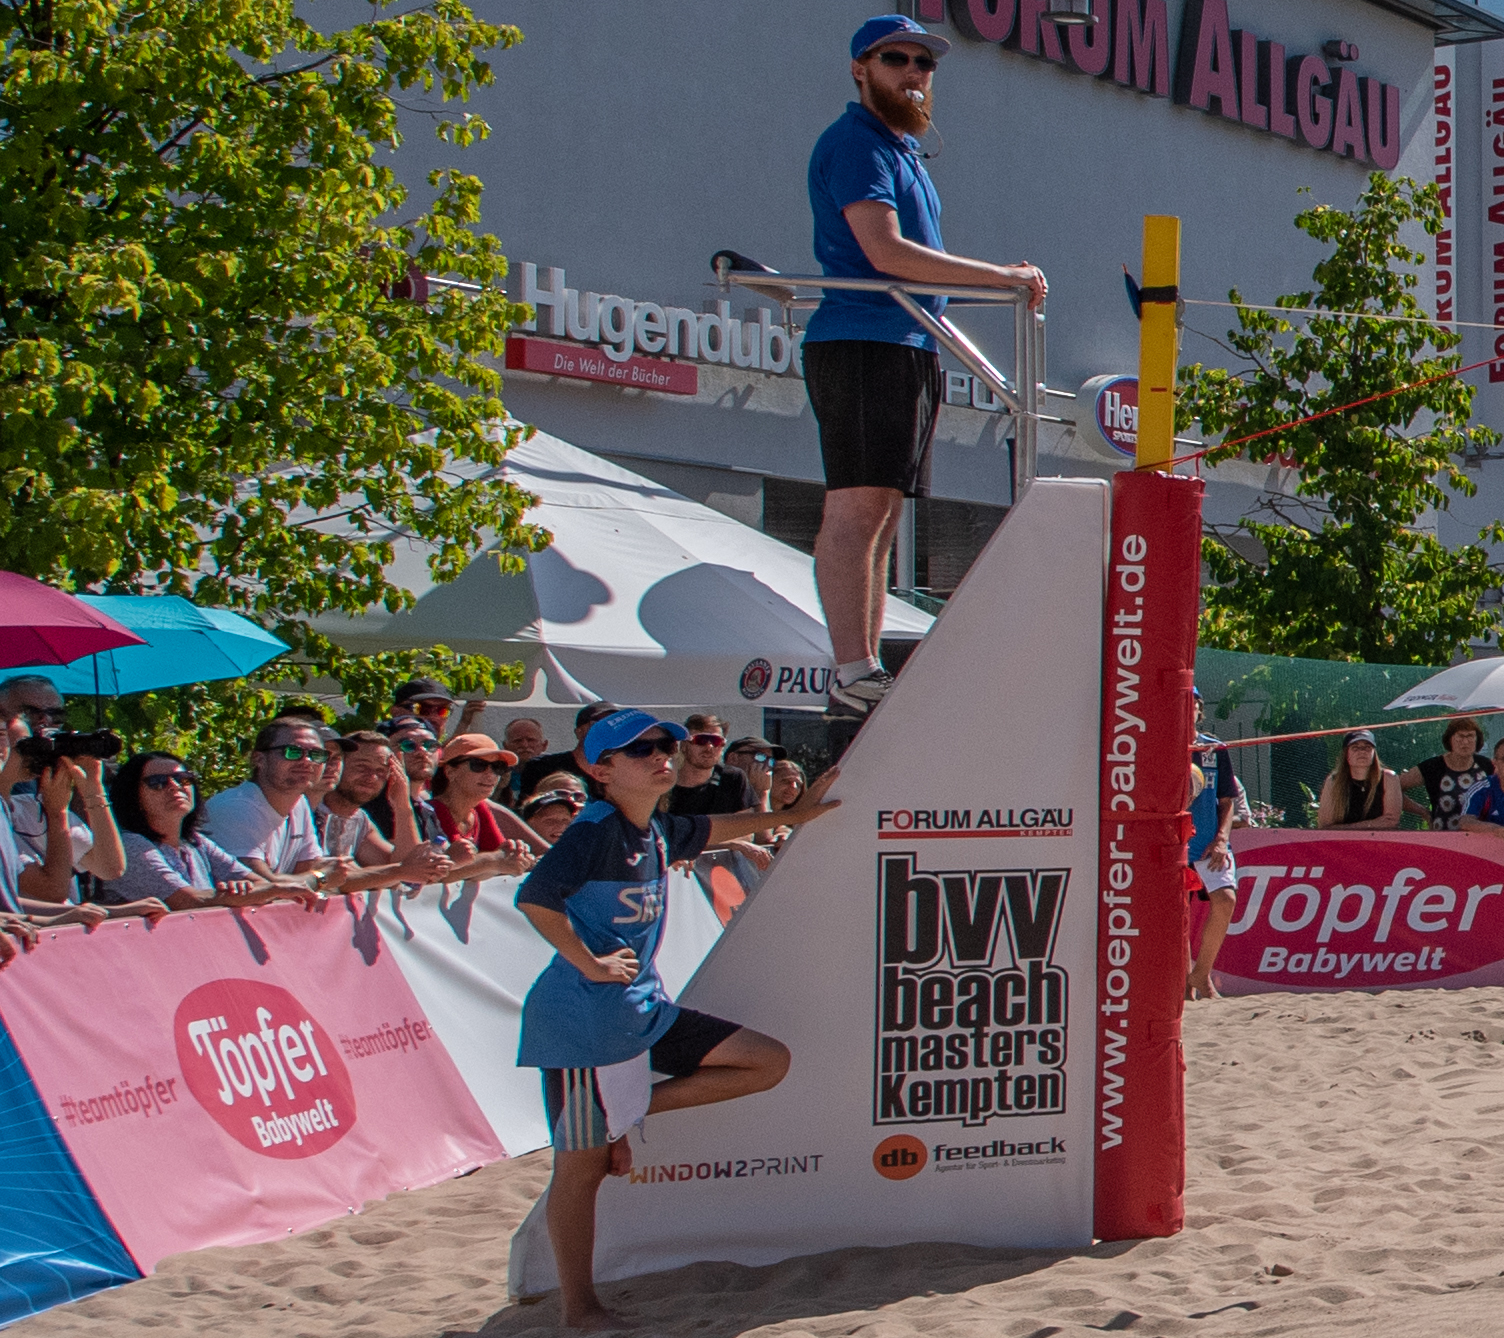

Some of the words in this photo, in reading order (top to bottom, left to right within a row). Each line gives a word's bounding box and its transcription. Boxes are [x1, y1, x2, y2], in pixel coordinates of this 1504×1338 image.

[554, 353, 575, 372] Die
[579, 357, 605, 377] Welt
[608, 360, 628, 379] der
[631, 368, 671, 387] Bücher
[877, 810, 971, 830] FORUM
[977, 807, 1074, 829] ALLGÄU
[883, 856, 1069, 966] bvv
[1226, 865, 1504, 943] Töpfer
[1257, 945, 1447, 978] Babywelt
[882, 962, 1064, 1032] beach
[187, 1006, 328, 1107] Töpfer
[338, 1015, 433, 1061] #teamtöpfer
[881, 1027, 1063, 1073] masters
[60, 1074, 177, 1129] #teamtöpfer
[880, 1071, 1062, 1121] Kempten
[250, 1098, 340, 1148] Babywelt
[629, 1153, 824, 1185] WINDOW2PRINT
[880, 1147, 919, 1168] db
[932, 1136, 1067, 1162] feedback
